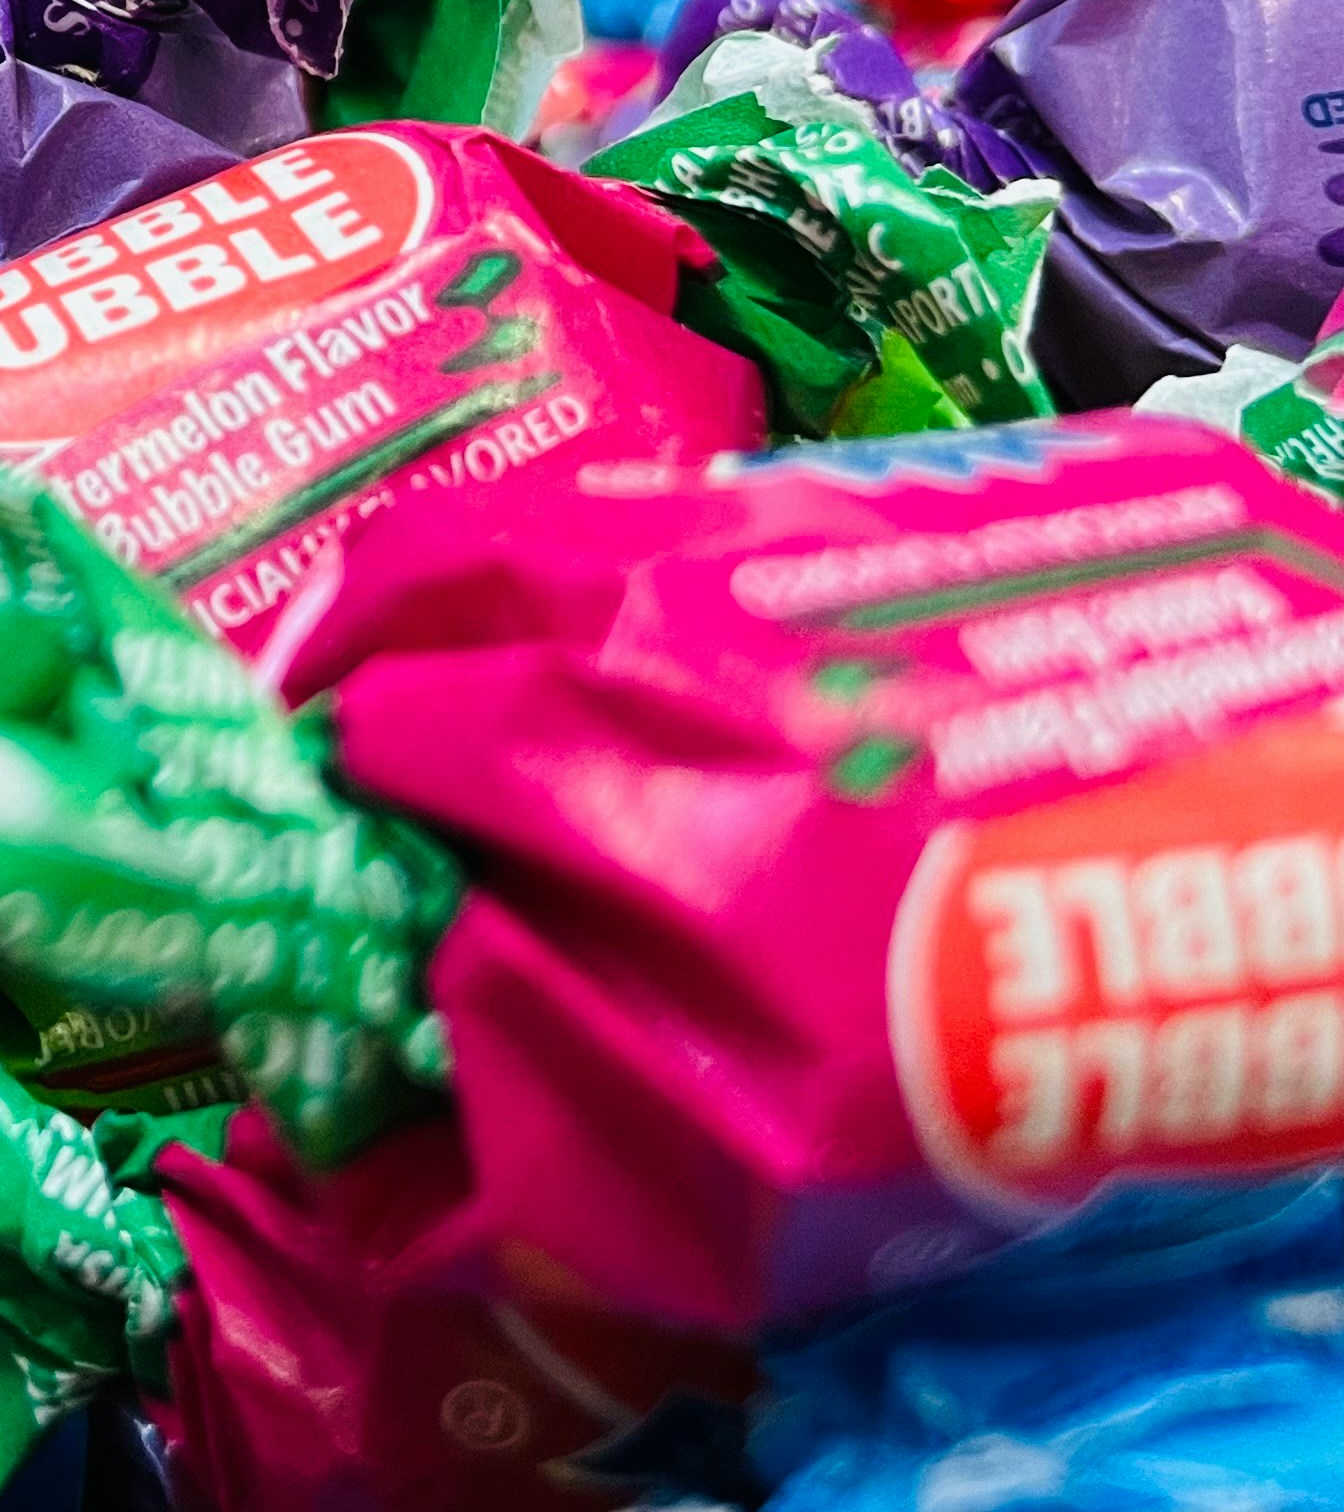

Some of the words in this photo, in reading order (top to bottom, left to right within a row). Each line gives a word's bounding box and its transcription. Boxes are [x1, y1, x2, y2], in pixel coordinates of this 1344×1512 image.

[62, 368, 280, 519] termelon
[264, 284, 433, 392] Flavor
[95, 454, 271, 566] Bubble
[264, 380, 399, 468] Gum
